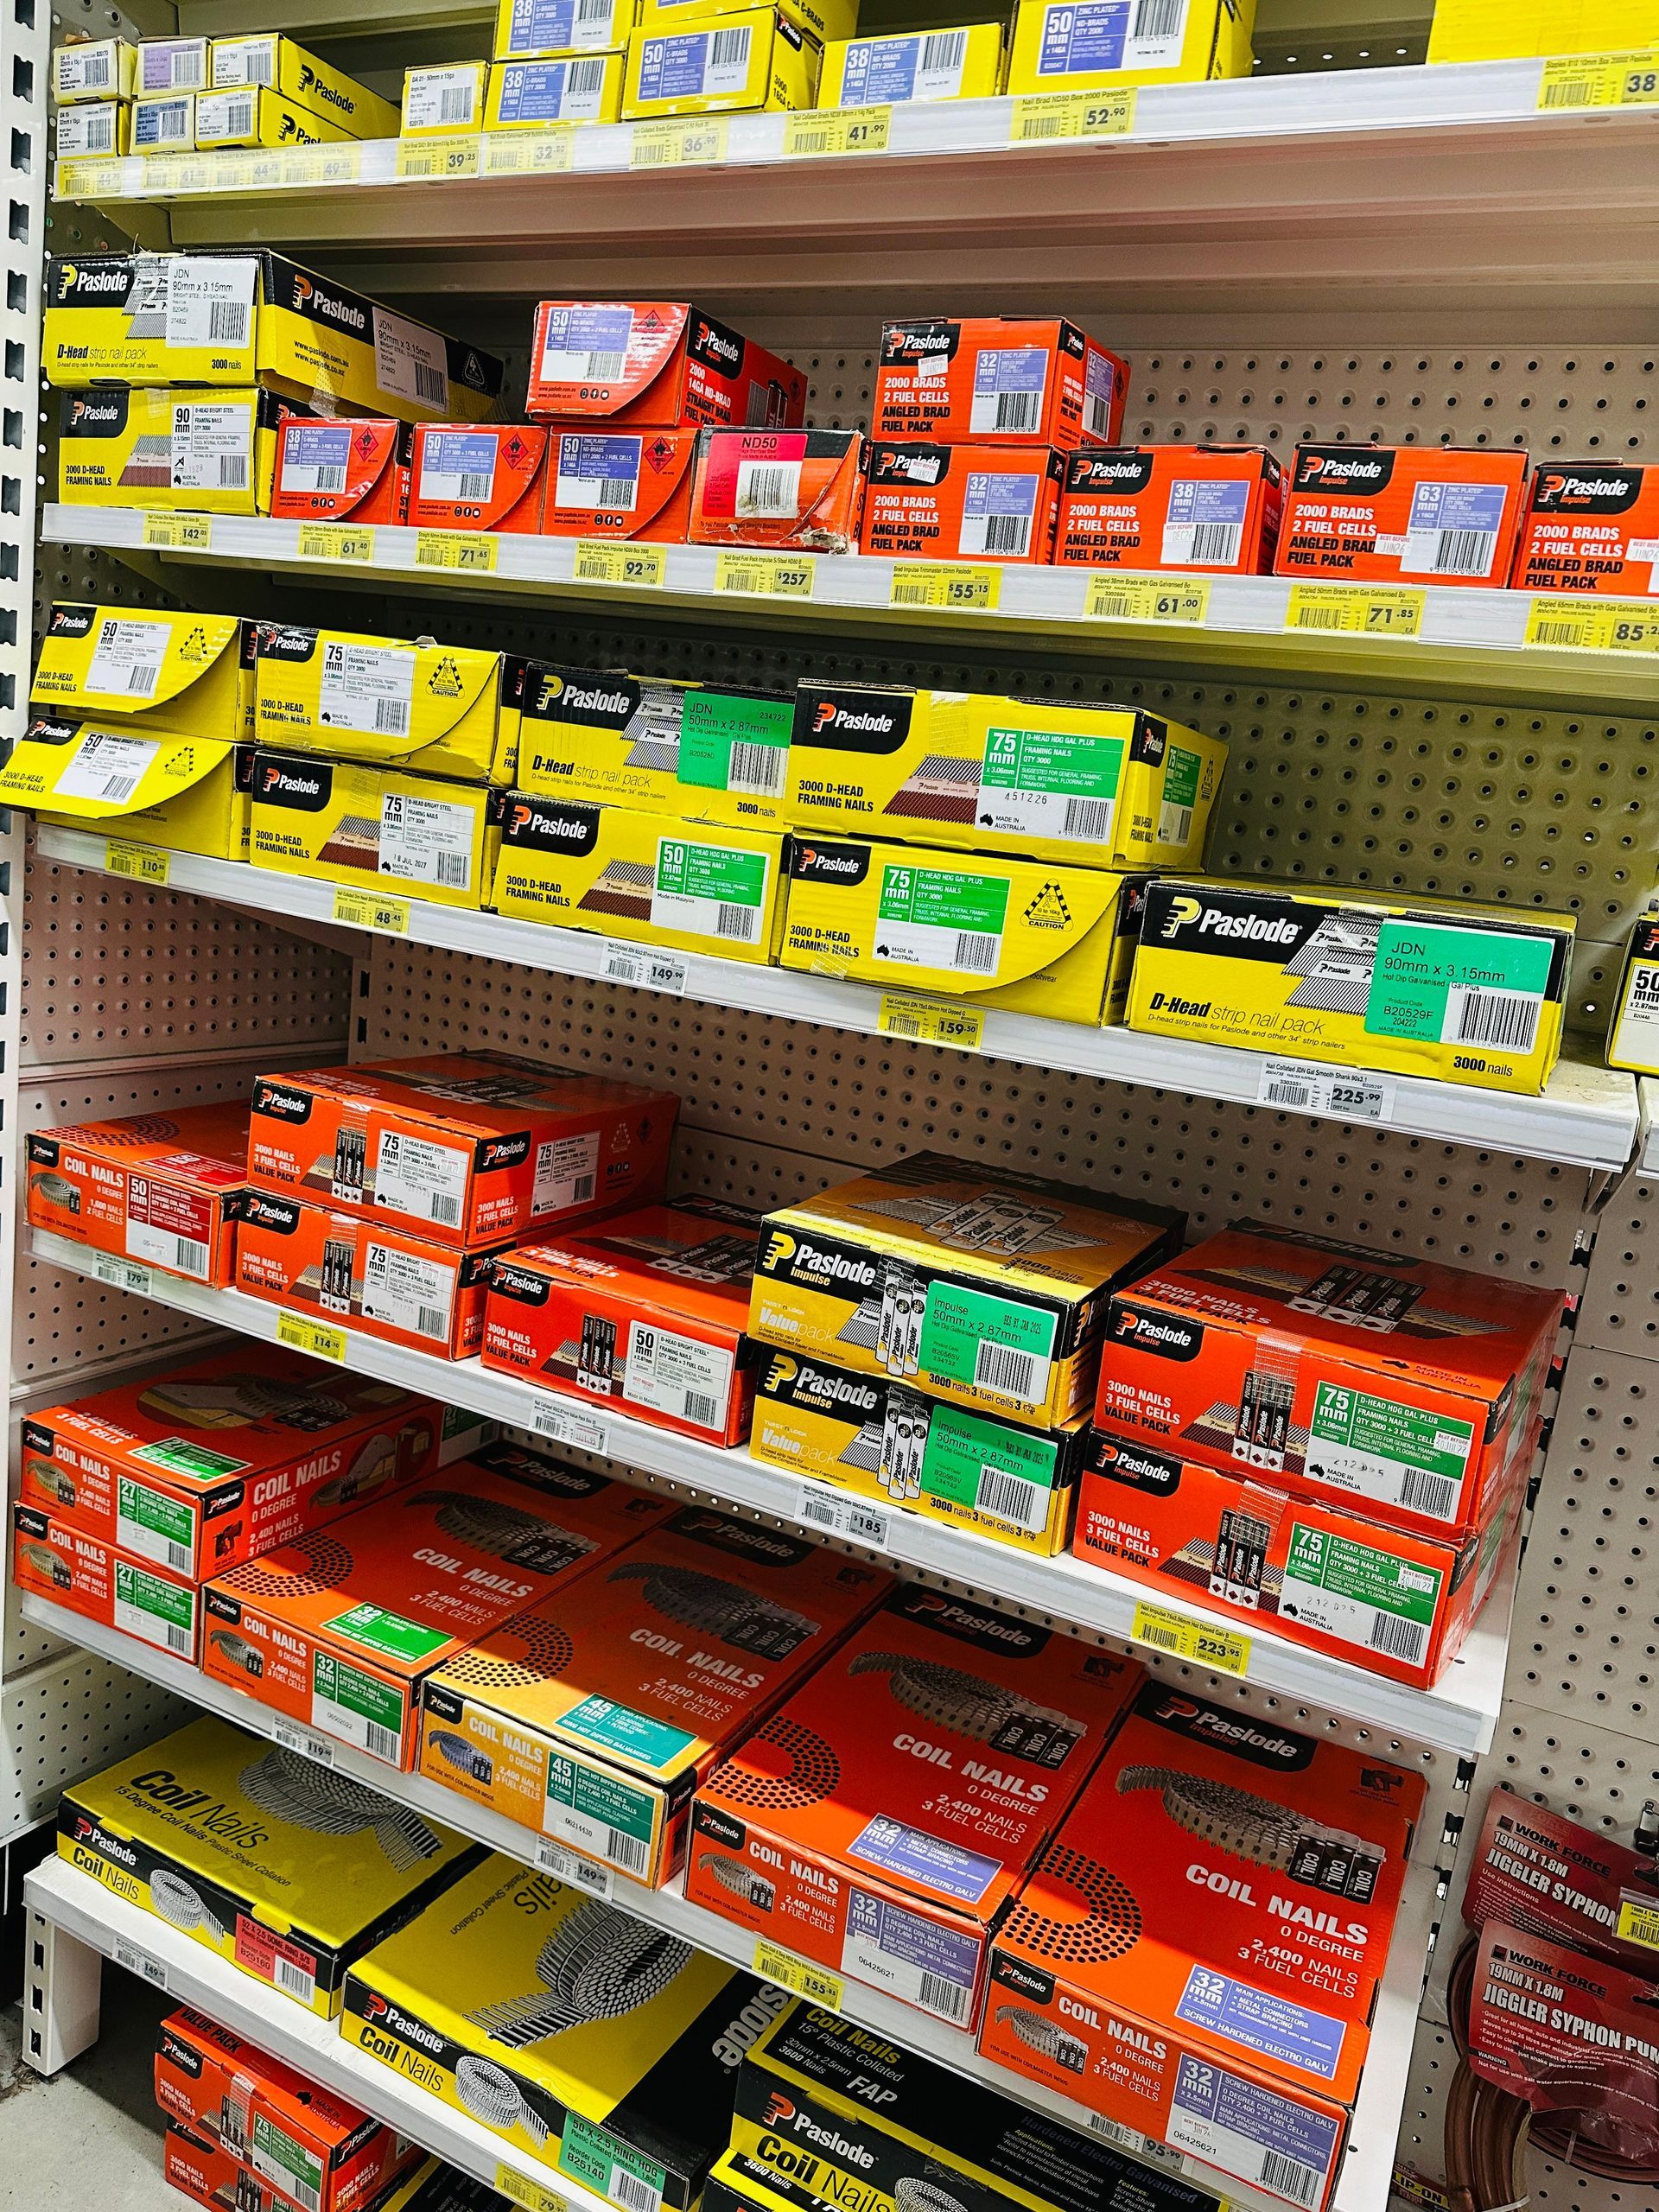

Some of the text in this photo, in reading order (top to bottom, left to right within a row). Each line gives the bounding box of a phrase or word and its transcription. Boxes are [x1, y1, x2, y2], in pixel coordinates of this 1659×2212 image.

[1049, 12, 1071, 33] 50
[1077, 19, 1109, 28] ND-BRADS
[645, 45, 663, 62] 50
[848, 48, 868, 67] 38
[505, 72, 523, 87] 38
[314, 79, 355, 114] Paslode
[1084, 92, 1100, 100] 2000
[1102, 90, 1128, 99] Paslode
[77, 270, 128, 291] Paslode
[174, 269, 189, 278] JDN
[172, 281, 197, 291] 90mm
[314, 295, 365, 328] Paslode
[708, 332, 739, 362] Paslode
[904, 334, 950, 350] Paslode
[57, 345, 147, 361] D-Head strip nail pack
[981, 354, 996, 368] 32
[212, 359, 241, 369] 3000 nails
[690, 363, 706, 378] 2000
[688, 378, 731, 406] 14GA ND-BRAD
[885, 377, 946, 388] 2000 BRADS
[884, 391, 949, 402] 2 FUEL CELLS
[176, 409, 190, 423] 90
[882, 406, 950, 417] ANGLED BRAD
[175, 423, 190, 432] mm
[882, 421, 933, 431] FUEL PACK
[742, 437, 777, 450] ND50
[1322, 460, 1382, 480] Paslode
[1419, 486, 1440, 502] 63
[778, 572, 806, 587] $257
[103, 622, 118, 636] 50
[562, 685, 630, 713] Paslode
[690, 703, 712, 715] JDN
[835, 710, 893, 732] Paslode
[993, 734, 1016, 751] 75
[278, 776, 319, 795] Paslode
[798, 780, 863, 797] 3000 D-HEAD
[386, 796, 402, 810] 75
[798, 794, 874, 812] FRAMING NAILS
[531, 818, 588, 840] Paslode
[995, 823, 1025, 831] AUSTRALIA
[1028, 920, 1065, 930] CAUTION
[1199, 912, 1299, 944] Paslode
[1392, 942, 1426, 956] JDN
[1385, 957, 1428, 972] 90mm
[1446, 965, 1505, 982] 3.15mm
[1384, 1005, 1433, 1020] B20529F
[1393, 1018, 1417, 1027] 204222
[1453, 1056, 1513, 1077] 3000 nails
[64, 1156, 124, 1187] COIL NAILS
[795, 1242, 875, 1285] Paslode
[505, 1270, 543, 1294] Paslode
[790, 1266, 830, 1287] Impulse
[760, 1308, 836, 1342] Valuepack
[1136, 1319, 1191, 1346] Paslode
[636, 1332, 653, 1348] 50
[929, 1373, 1014, 1407] 3000 nails 3 fuel cells
[1325, 1386, 1349, 1409] 75
[252, 1452, 341, 1505] COIL NAILS
[854, 1515, 881, 1534] $185
[942, 1607, 1031, 1646] Paslode
[469, 1716, 543, 1763] COIL NAILS
[1194, 1712, 1298, 1758] Paslode
[130, 1770, 270, 1848] Coil Nails
[91, 1829, 137, 1866] Paslode
[1493, 1832, 1568, 1878] 19MM X 1.8M
[1515, 1823, 1611, 1877] WORK FORCE
[1485, 1848, 1550, 1894] JIGGLER
[1553, 1883, 1618, 1927] SYPHON
[1185, 1864, 1369, 1945] COIL NAILS
[1281, 1925, 1364, 1963] 0 DEGREE
[1238, 1946, 1355, 1999] 3 FUEL CELLS
[1251, 1939, 1358, 1985] 2,400 NAILS
[385, 2008, 444, 2054] Paslode
[1184, 2008, 1328, 2073] SCREW HARDENED ELECTRO GALV
[359, 2025, 444, 2092] Coil Nails
[847, 2075, 898, 2105] FAP
[794, 2113, 877, 2169] Paslode
[1173, 2130, 1217, 2155] 06425621
[567, 2152, 605, 2182] B25140
